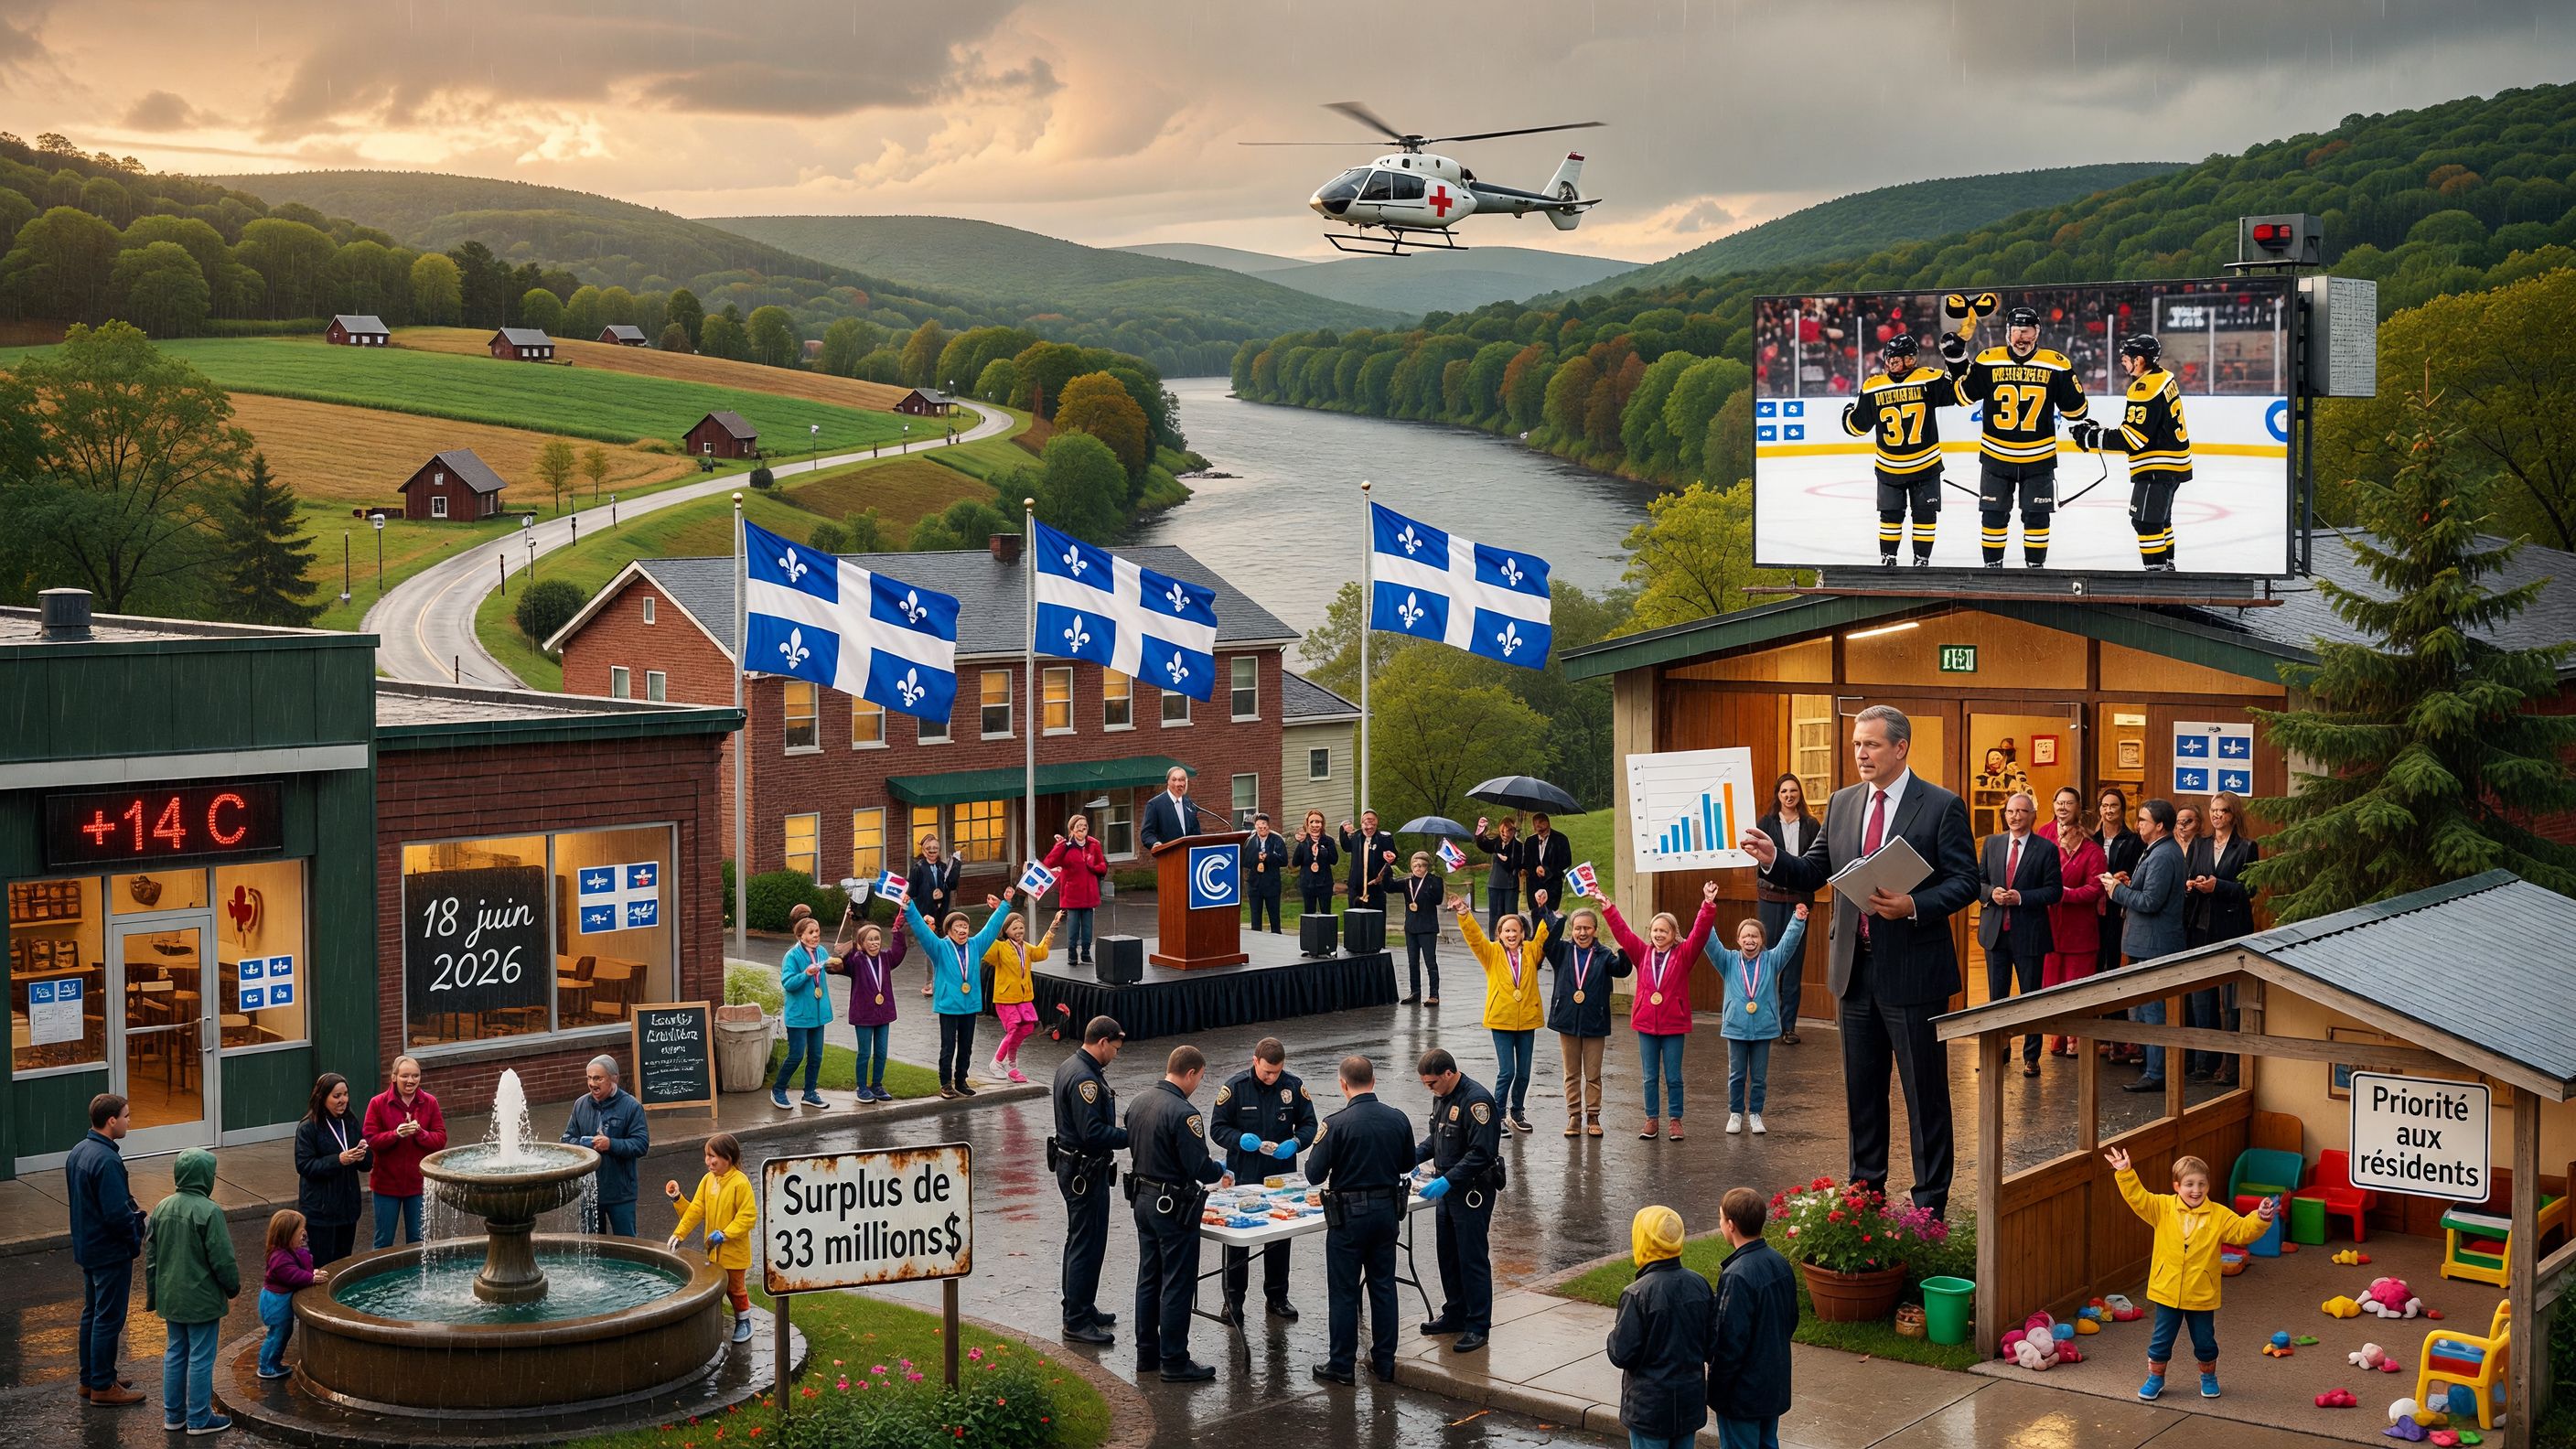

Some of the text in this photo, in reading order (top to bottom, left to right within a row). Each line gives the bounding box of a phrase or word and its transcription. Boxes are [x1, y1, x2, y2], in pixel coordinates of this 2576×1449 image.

[1879, 402, 1927, 446] 37
[1992, 383, 2047, 432] 37
[82, 793, 247, 851] +14 C
[423, 896, 534, 949] 18 juin
[429, 945, 523, 993] 2026
[2373, 1085, 2469, 1122] Priorité
[2396, 1126, 2442, 1150] aux
[2360, 1148, 2479, 1187] résidents
[783, 1164, 950, 1222] Surplus de
[775, 1210, 962, 1271] 33 millions$
